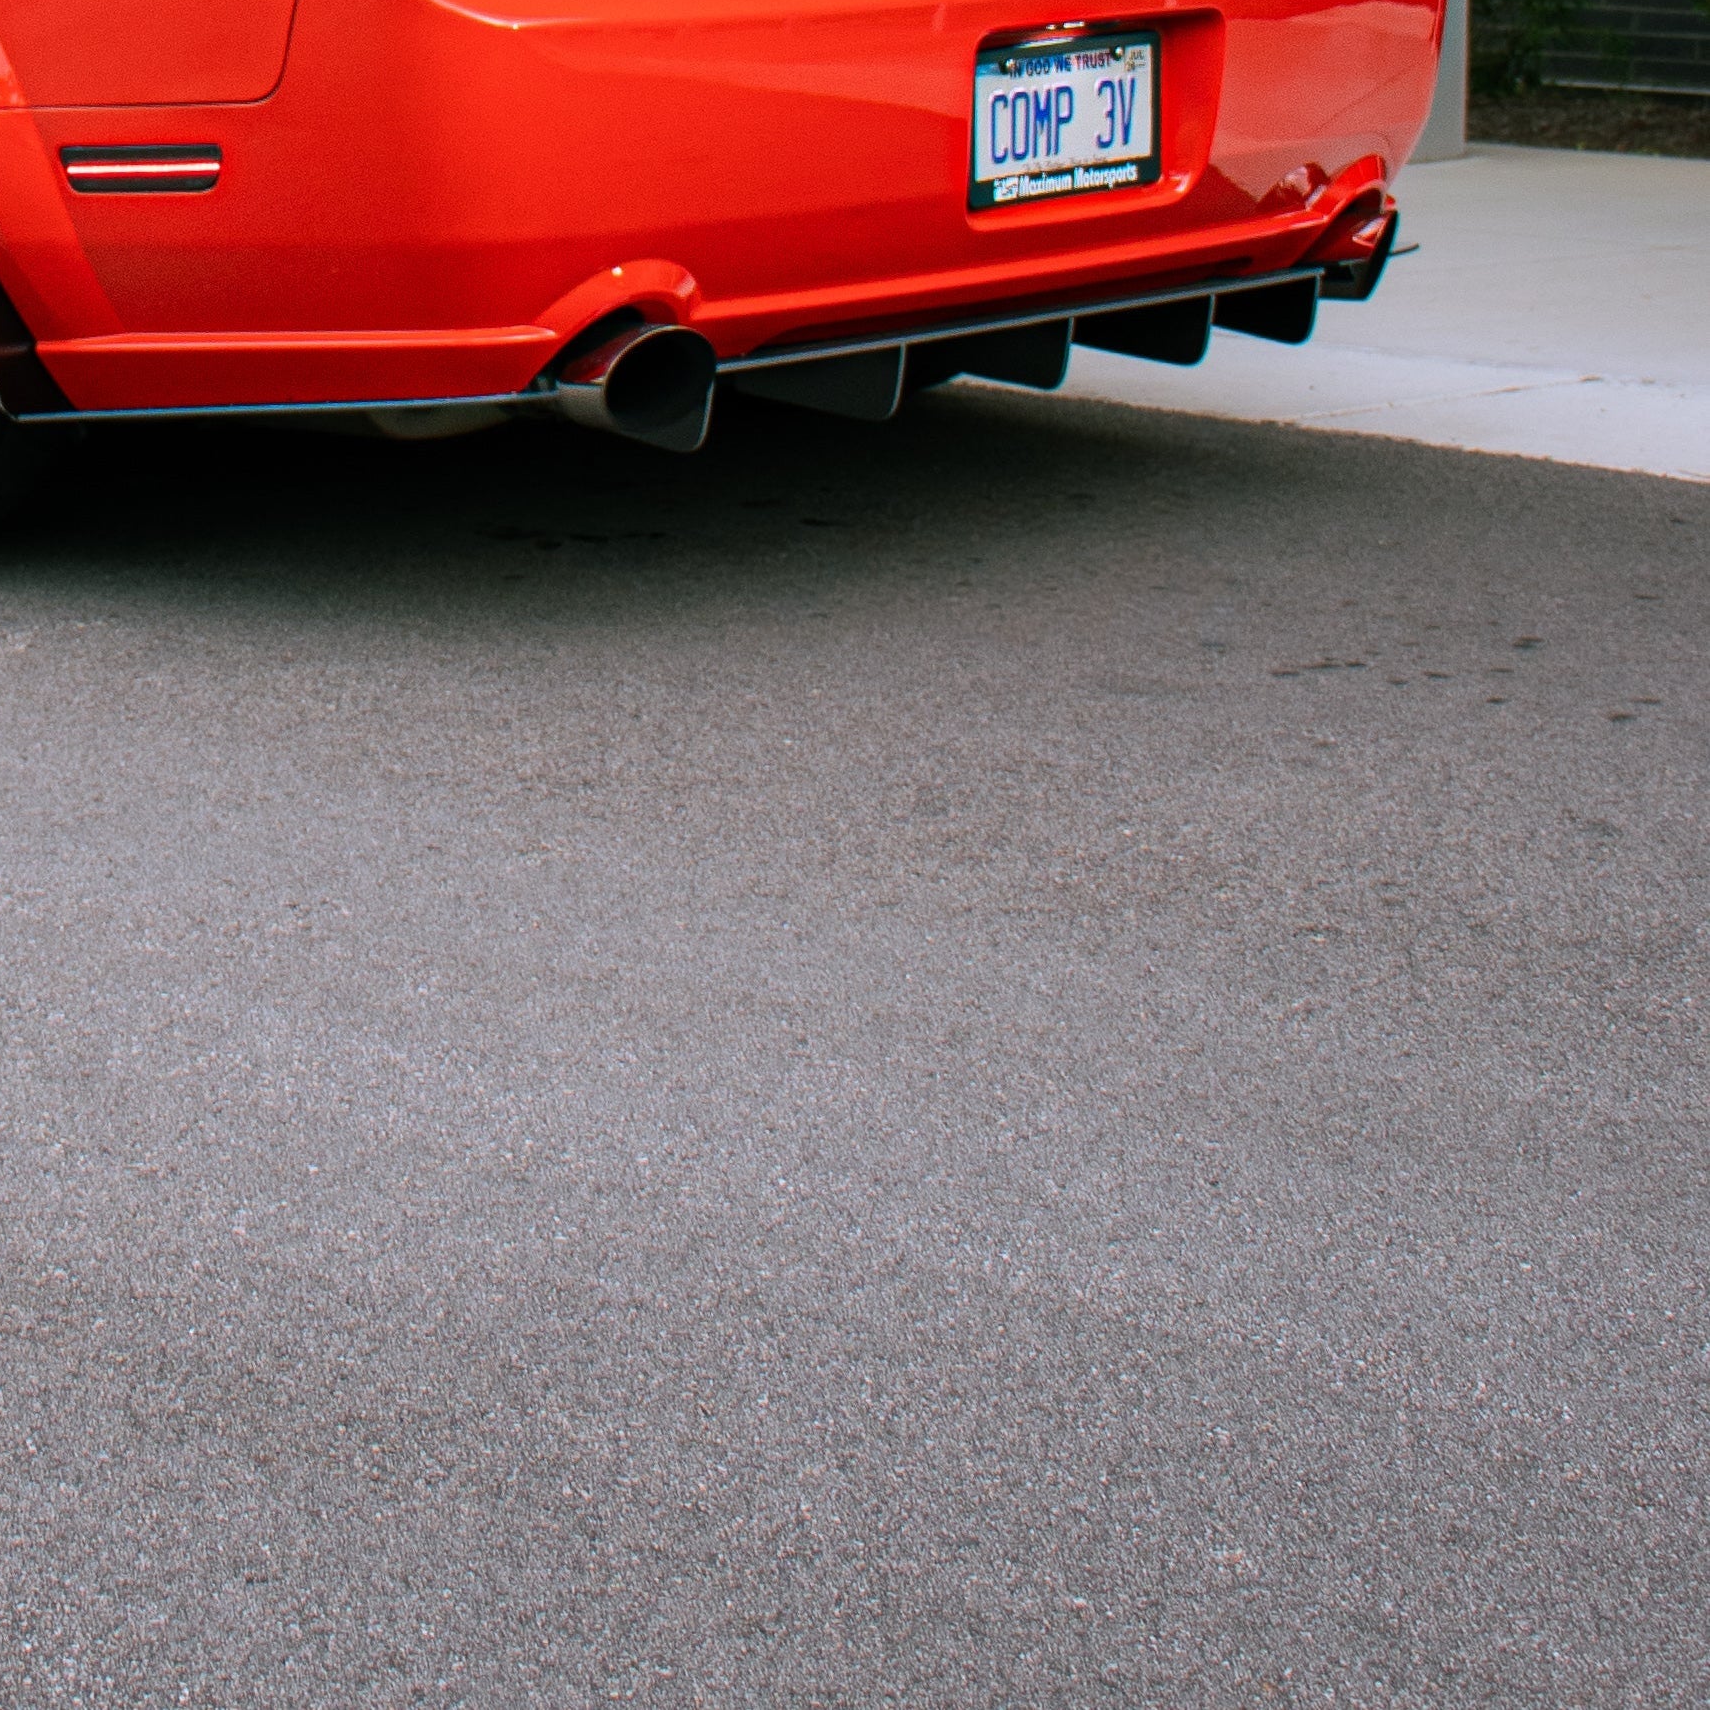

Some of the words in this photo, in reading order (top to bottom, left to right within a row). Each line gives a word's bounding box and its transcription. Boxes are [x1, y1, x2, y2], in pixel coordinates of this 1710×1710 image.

[1026, 57, 1050, 76] GOD
[1053, 54, 1072, 73] WE
[1074, 52, 1112, 71] TRUST
[991, 86, 1073, 163] COMP
[1096, 76, 1136, 149] 3V
[1019, 172, 1073, 197] Maximum
[1073, 162, 1139, 189] Motorsports
